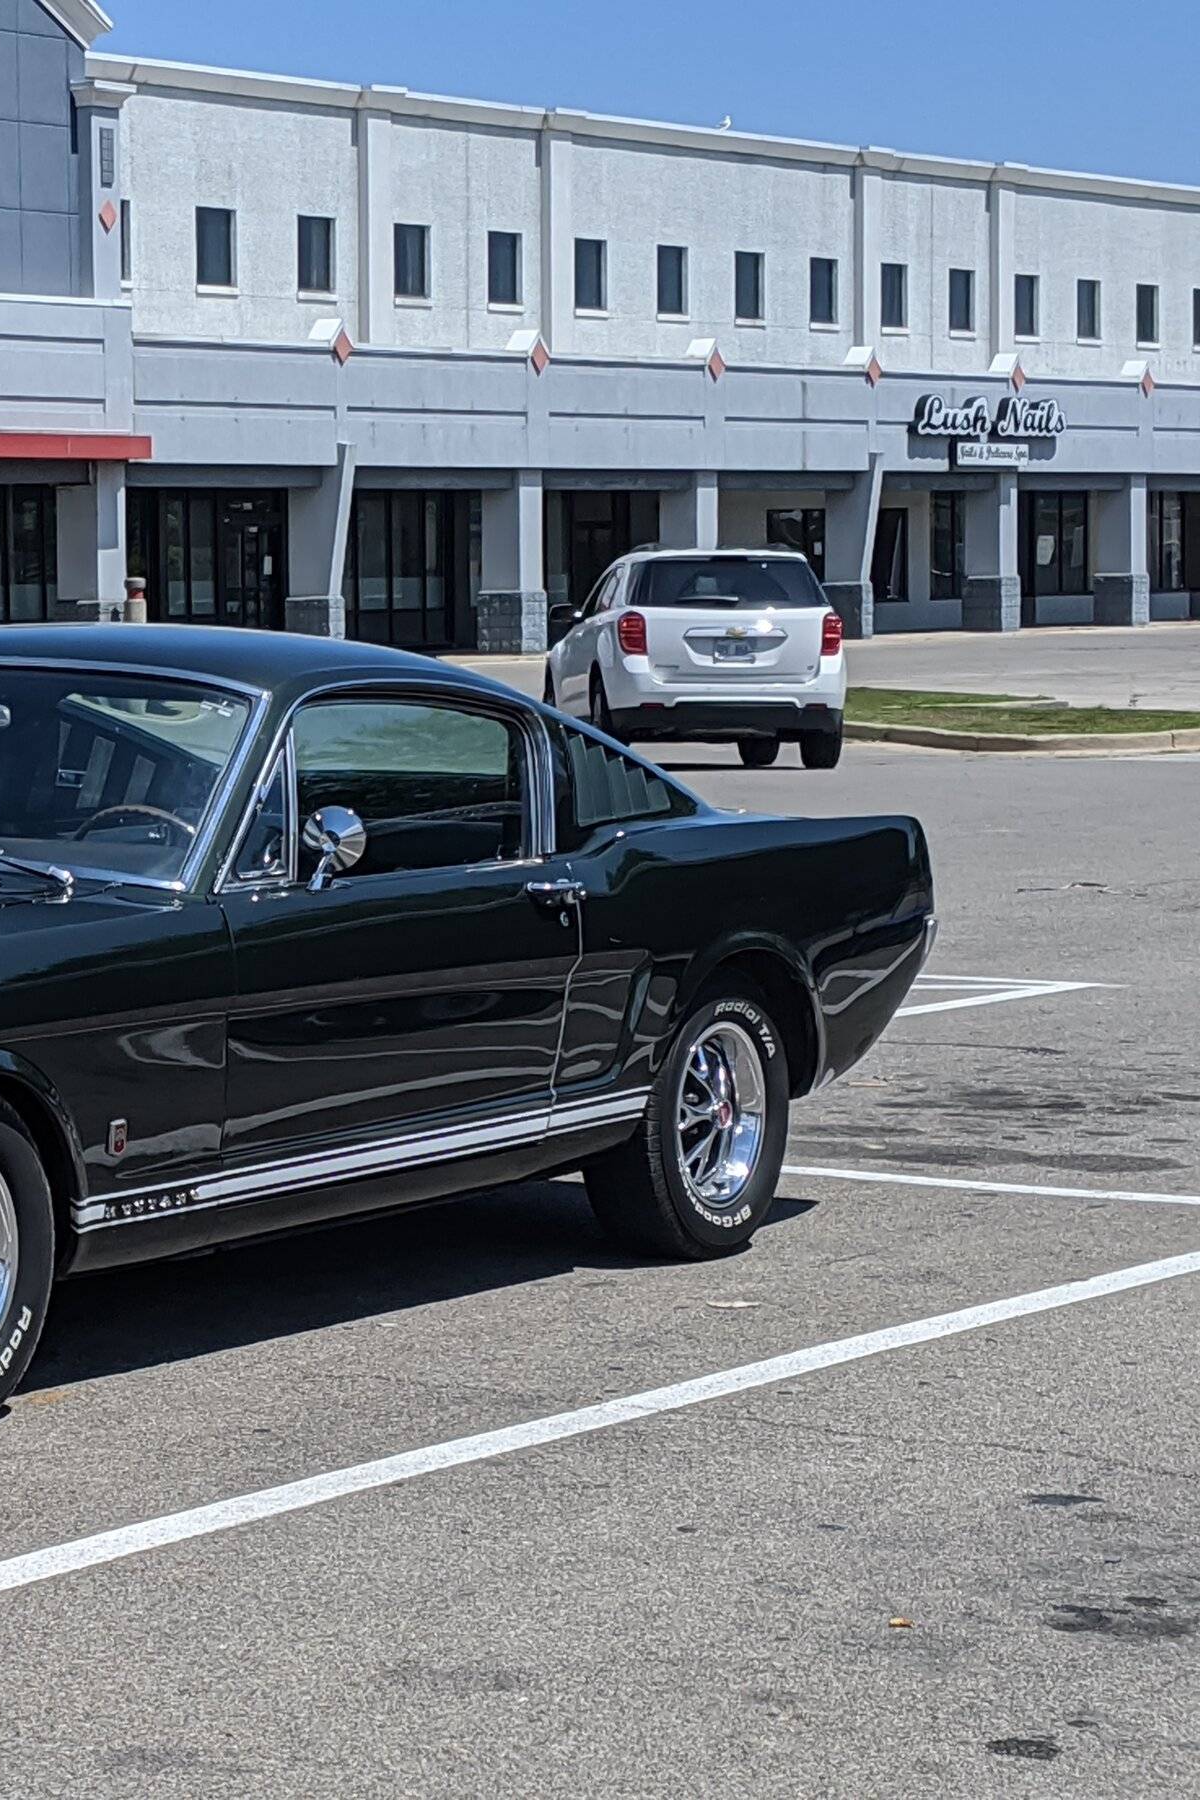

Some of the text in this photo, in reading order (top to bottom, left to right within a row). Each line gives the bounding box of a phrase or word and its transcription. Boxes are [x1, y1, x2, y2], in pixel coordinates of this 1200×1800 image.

[920, 396, 1066, 434] Lush Nails
[713, 1001, 776, 1059] Radial T/A
